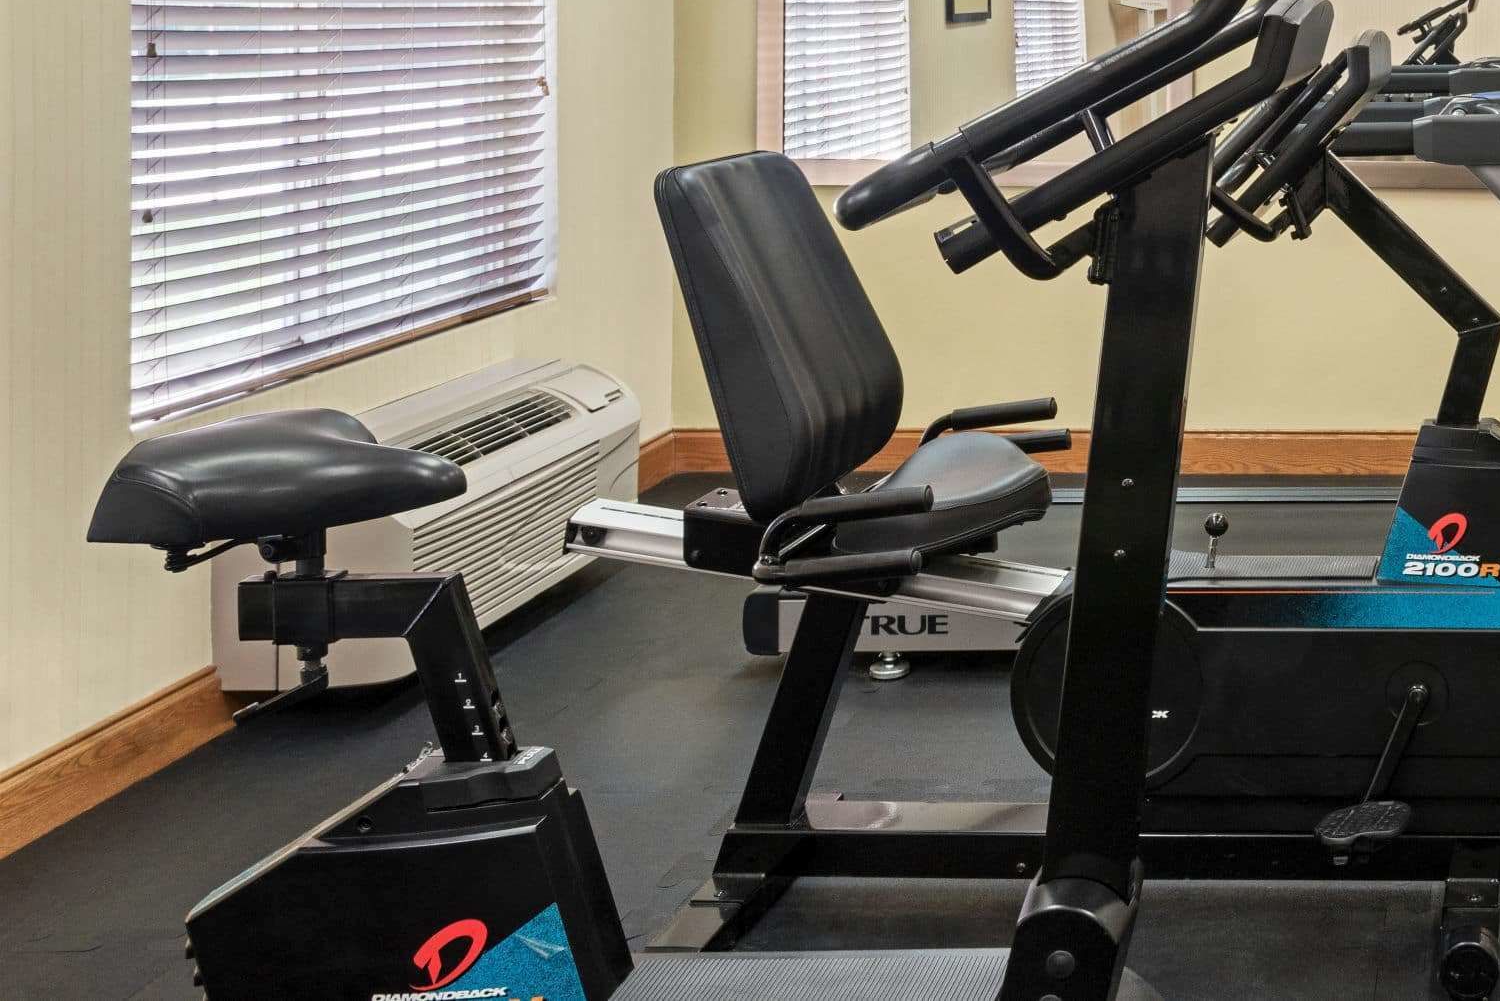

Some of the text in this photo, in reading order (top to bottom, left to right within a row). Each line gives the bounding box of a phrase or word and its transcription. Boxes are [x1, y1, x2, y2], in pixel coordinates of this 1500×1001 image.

[1405, 553, 1481, 562] DIAMONDBACK
[1402, 561, 1500, 578] 2100R
[864, 614, 949, 635] RUE
